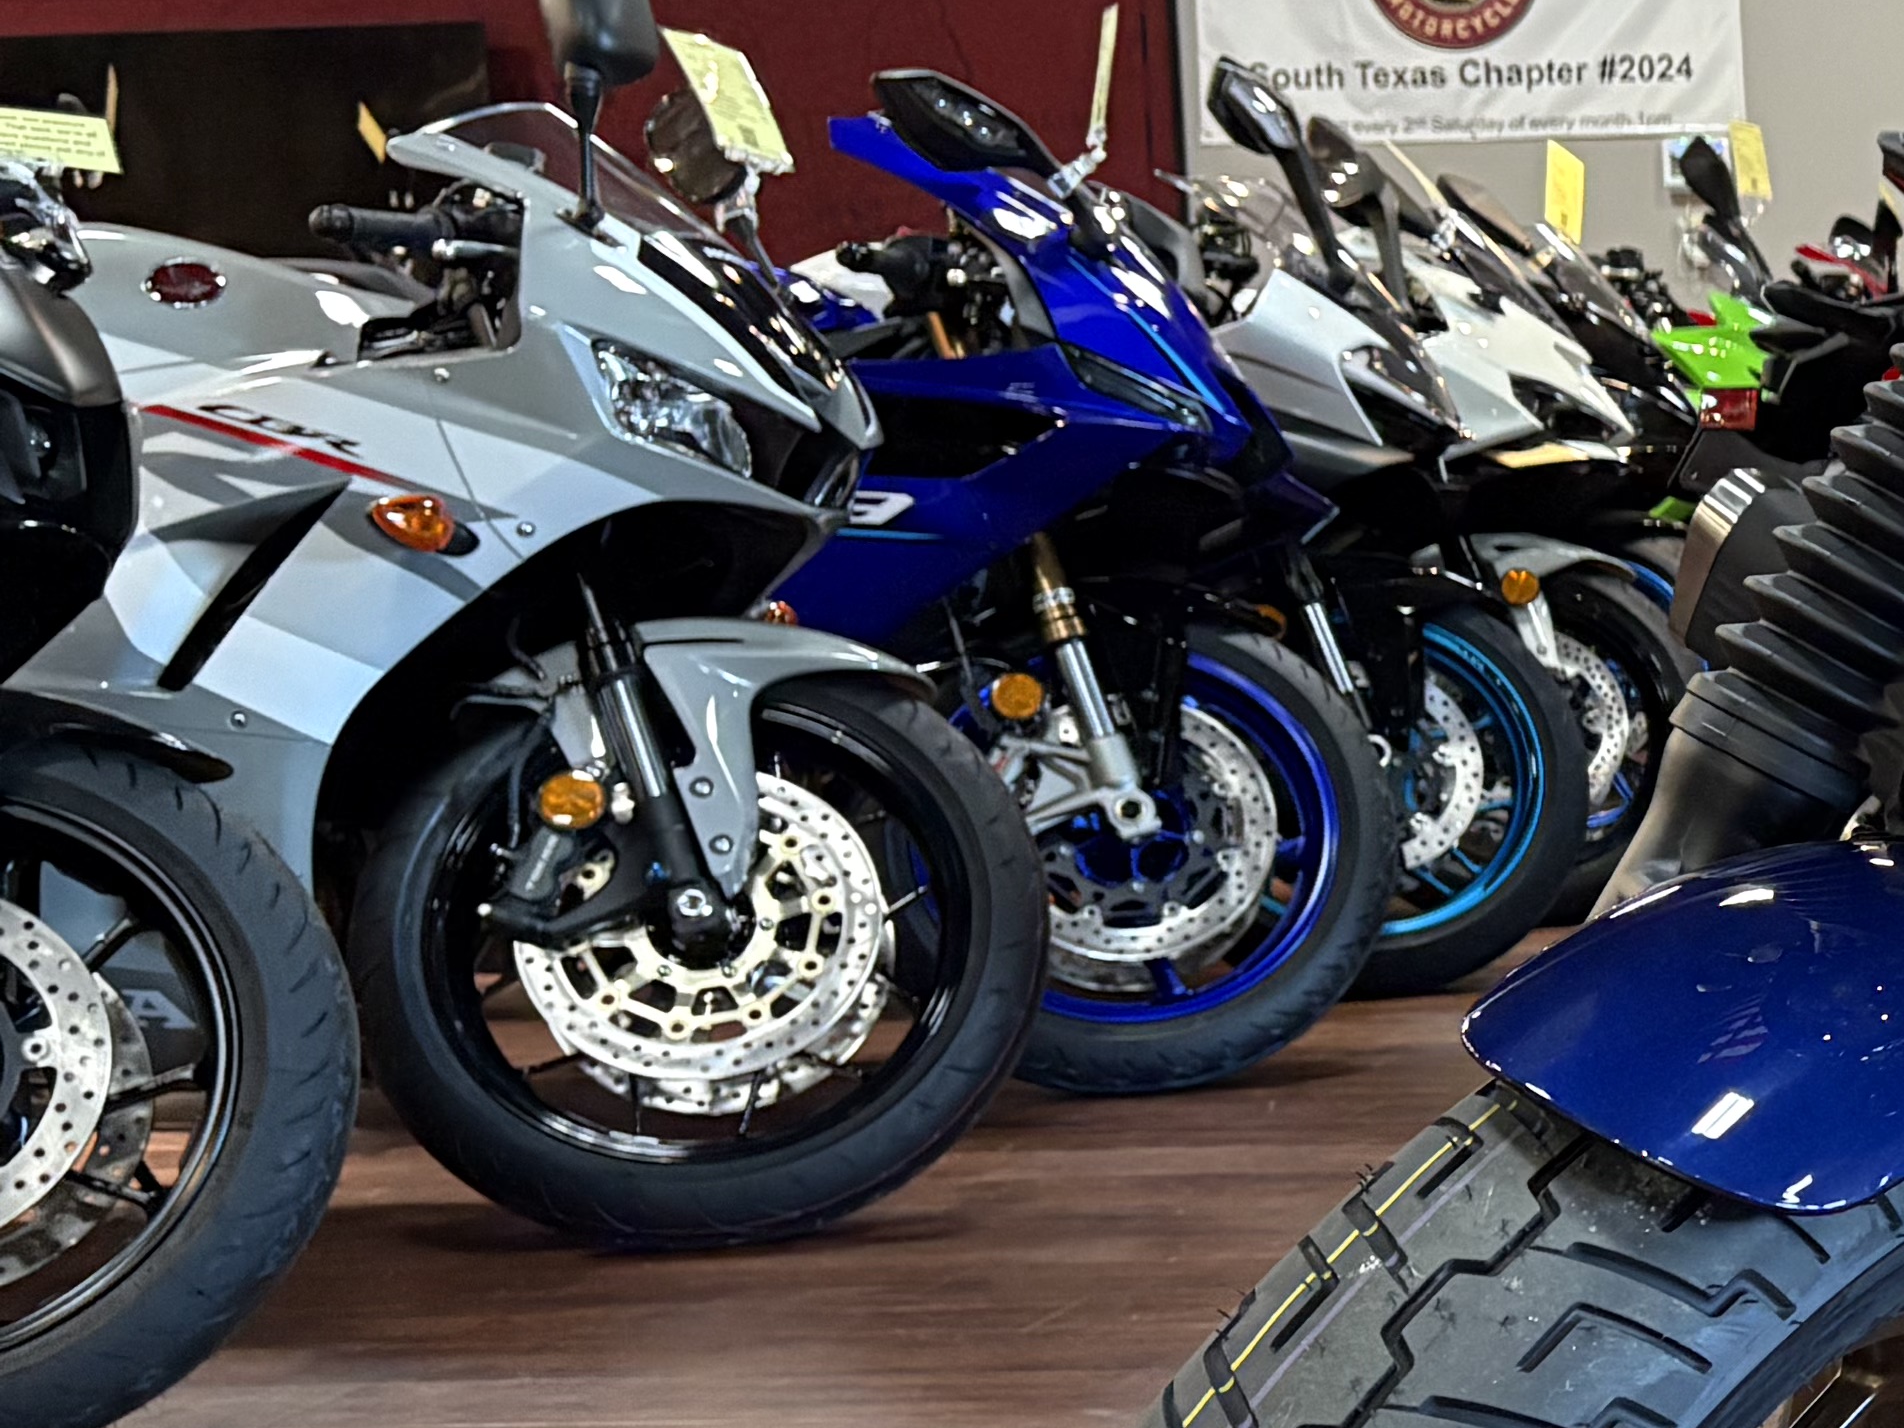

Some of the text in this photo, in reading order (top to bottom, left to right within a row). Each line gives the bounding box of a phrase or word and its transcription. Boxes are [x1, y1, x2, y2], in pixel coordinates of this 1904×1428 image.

[1355, 59, 1449, 90] Texas
[1459, 57, 1588, 93] Chapter
[1599, 52, 1695, 85] #2024
